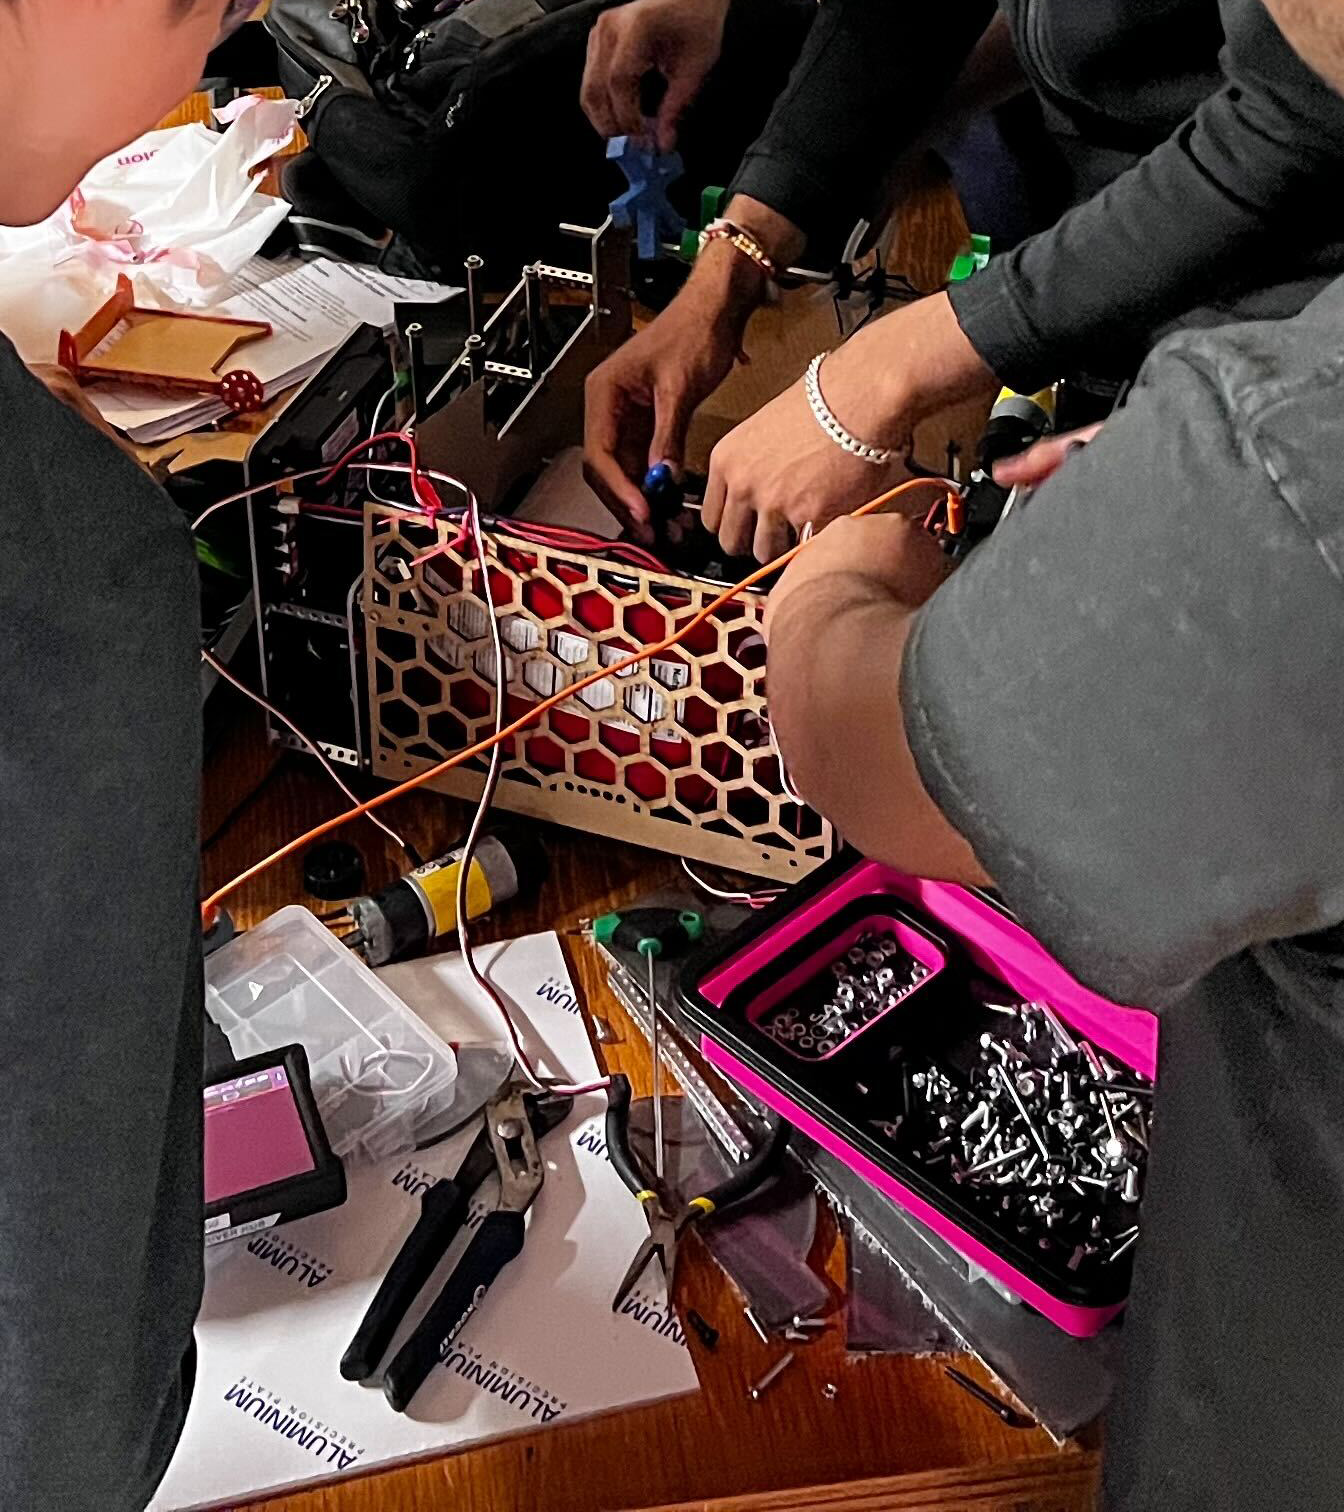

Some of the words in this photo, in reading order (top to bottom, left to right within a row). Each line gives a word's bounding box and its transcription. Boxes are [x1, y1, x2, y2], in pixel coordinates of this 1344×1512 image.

[239, 1375, 282, 1405] PLATE
[223, 1383, 358, 1470] ALUMINIUM
[290, 1405, 366, 1455] PRECISION
